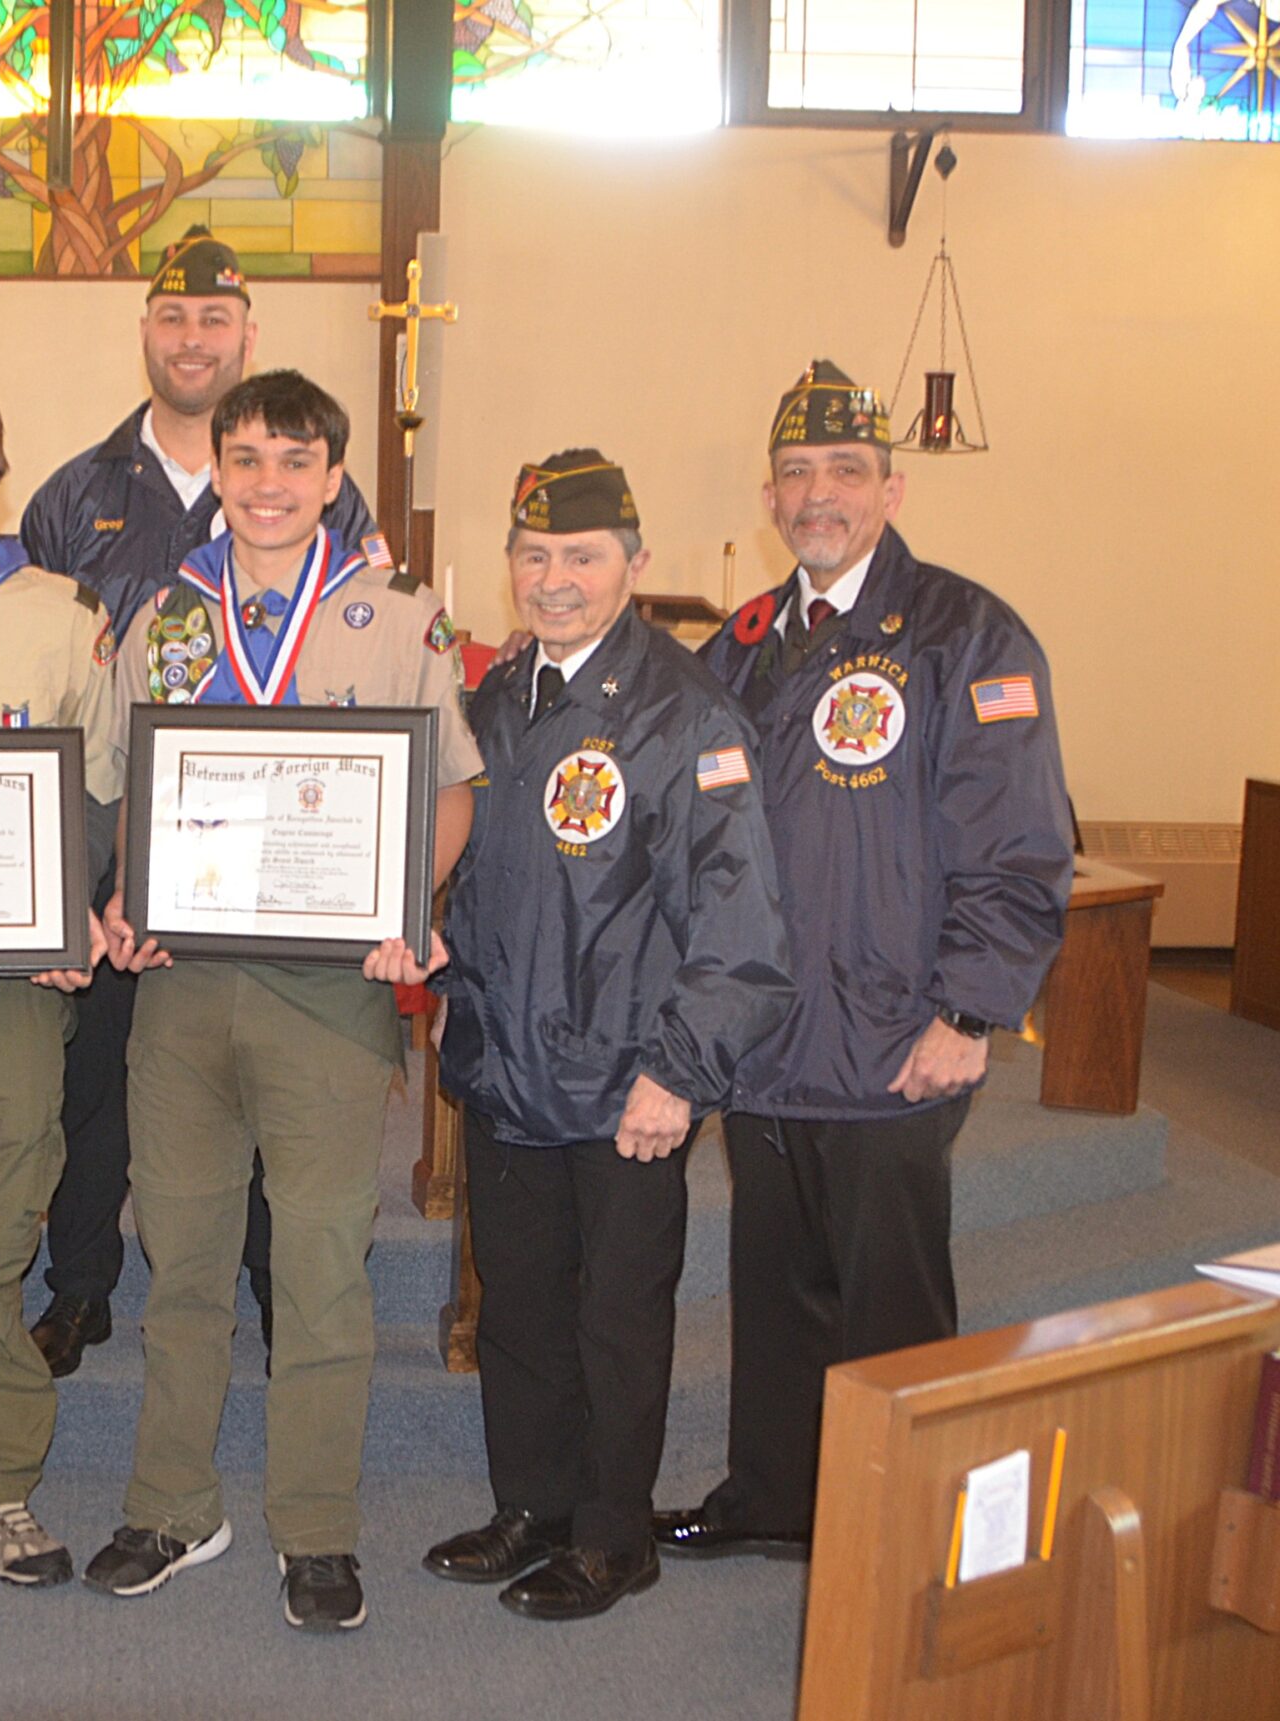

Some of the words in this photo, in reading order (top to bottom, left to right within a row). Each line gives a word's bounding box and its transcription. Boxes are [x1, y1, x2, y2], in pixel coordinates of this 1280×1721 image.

[786, 416, 805, 427] VFW
[581, 736, 615, 753] POST
[184, 760, 246, 782] Veterans
[252, 763, 268, 780] of
[270, 759, 330, 783] Foreign
[335, 759, 376, 777] Wars
[814, 758, 847, 788] Post
[848, 766, 888, 789] 4662
[555, 840, 588, 857] 4662
